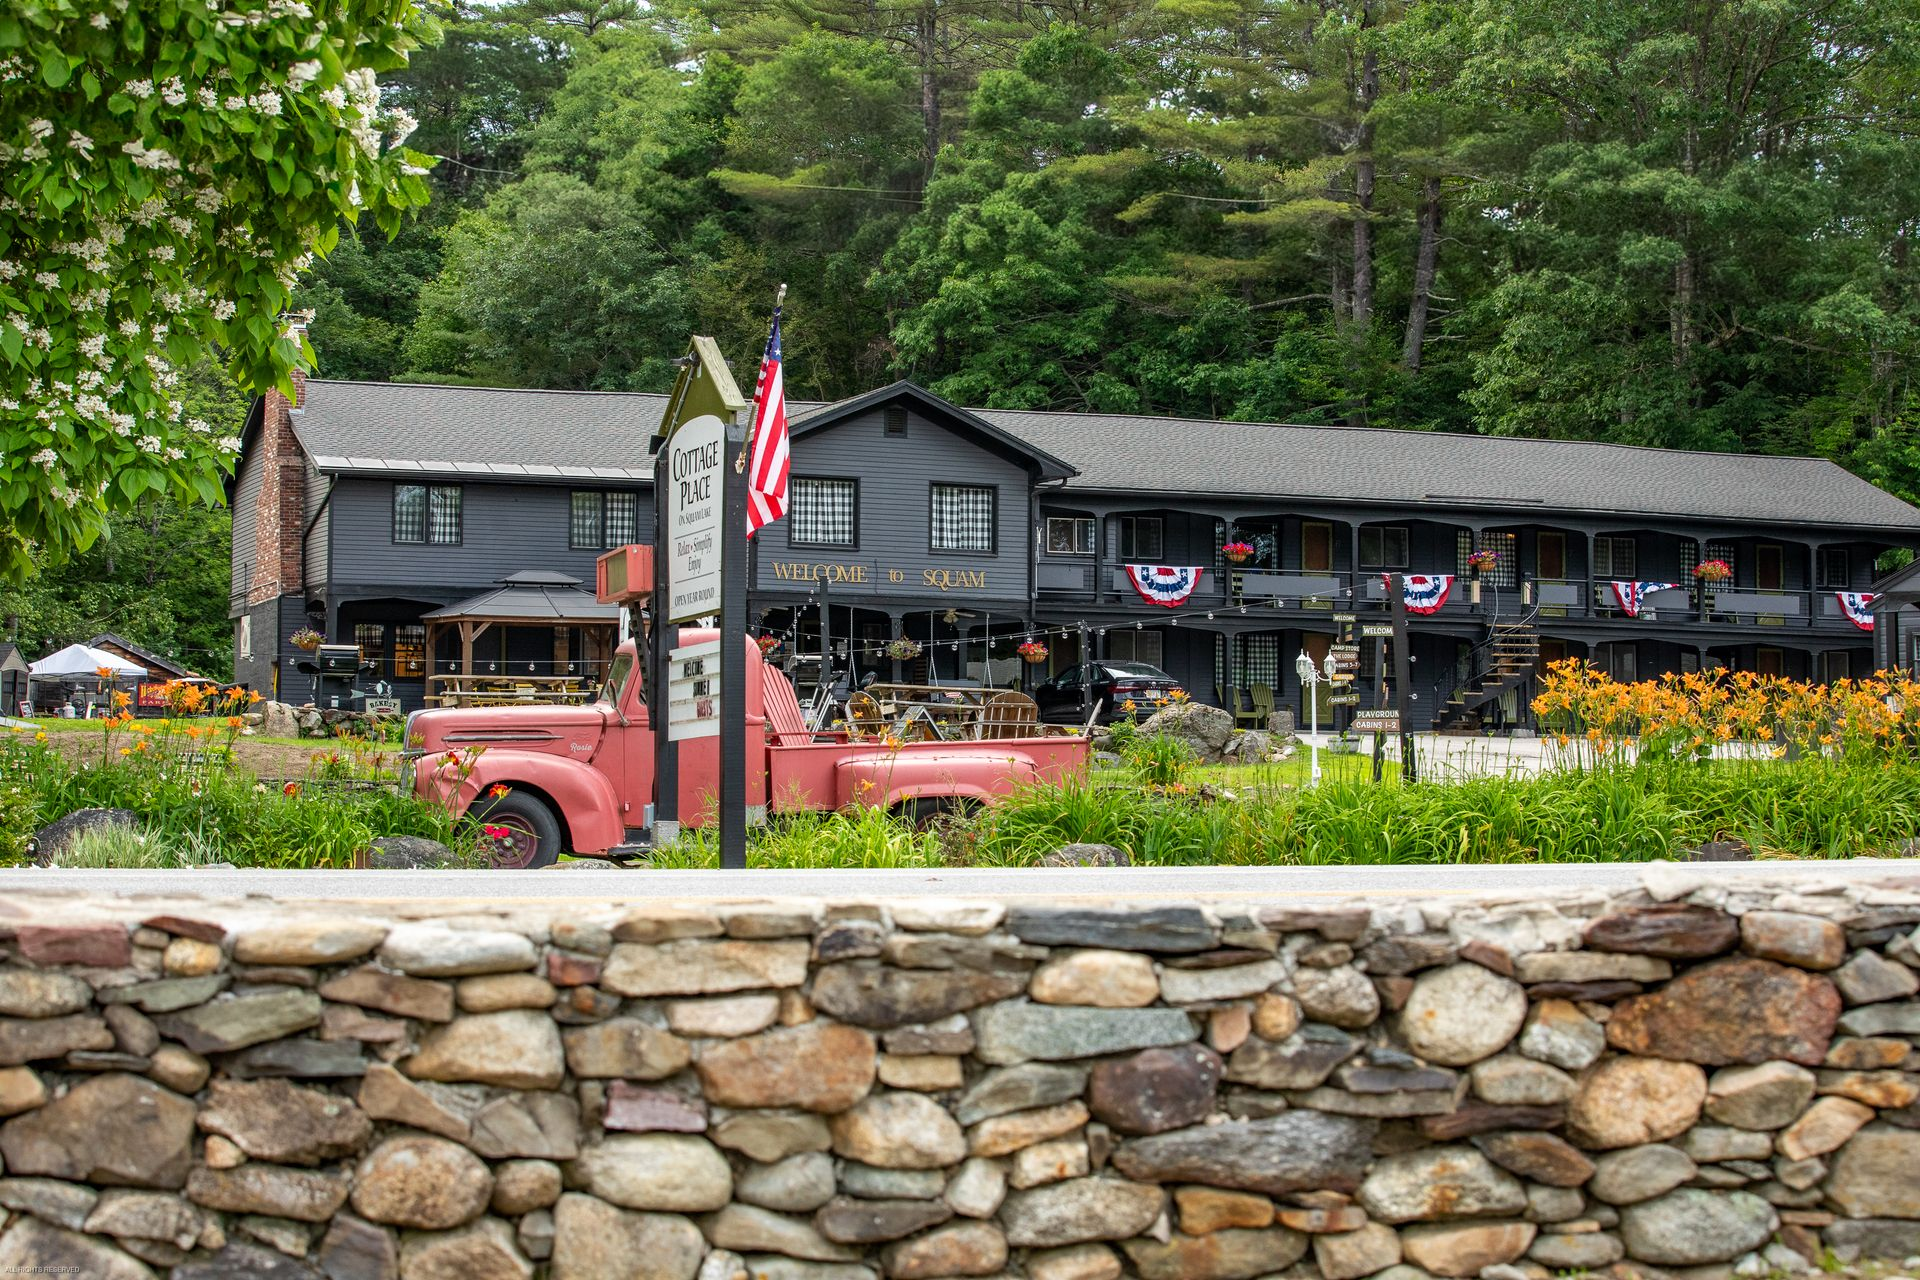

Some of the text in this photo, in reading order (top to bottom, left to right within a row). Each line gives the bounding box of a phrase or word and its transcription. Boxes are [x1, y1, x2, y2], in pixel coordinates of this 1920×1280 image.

[673, 440, 718, 482] COTTAGE
[680, 475, 711, 512] PLACE
[771, 562, 986, 591] WELCOME to SQUAM
[674, 586, 715, 607] OPEN YEAR ROUND
[1363, 627, 1393, 635] WELCOM
[1356, 710, 1399, 719] PLAYGROUN
[570, 742, 592, 753] Rosie
